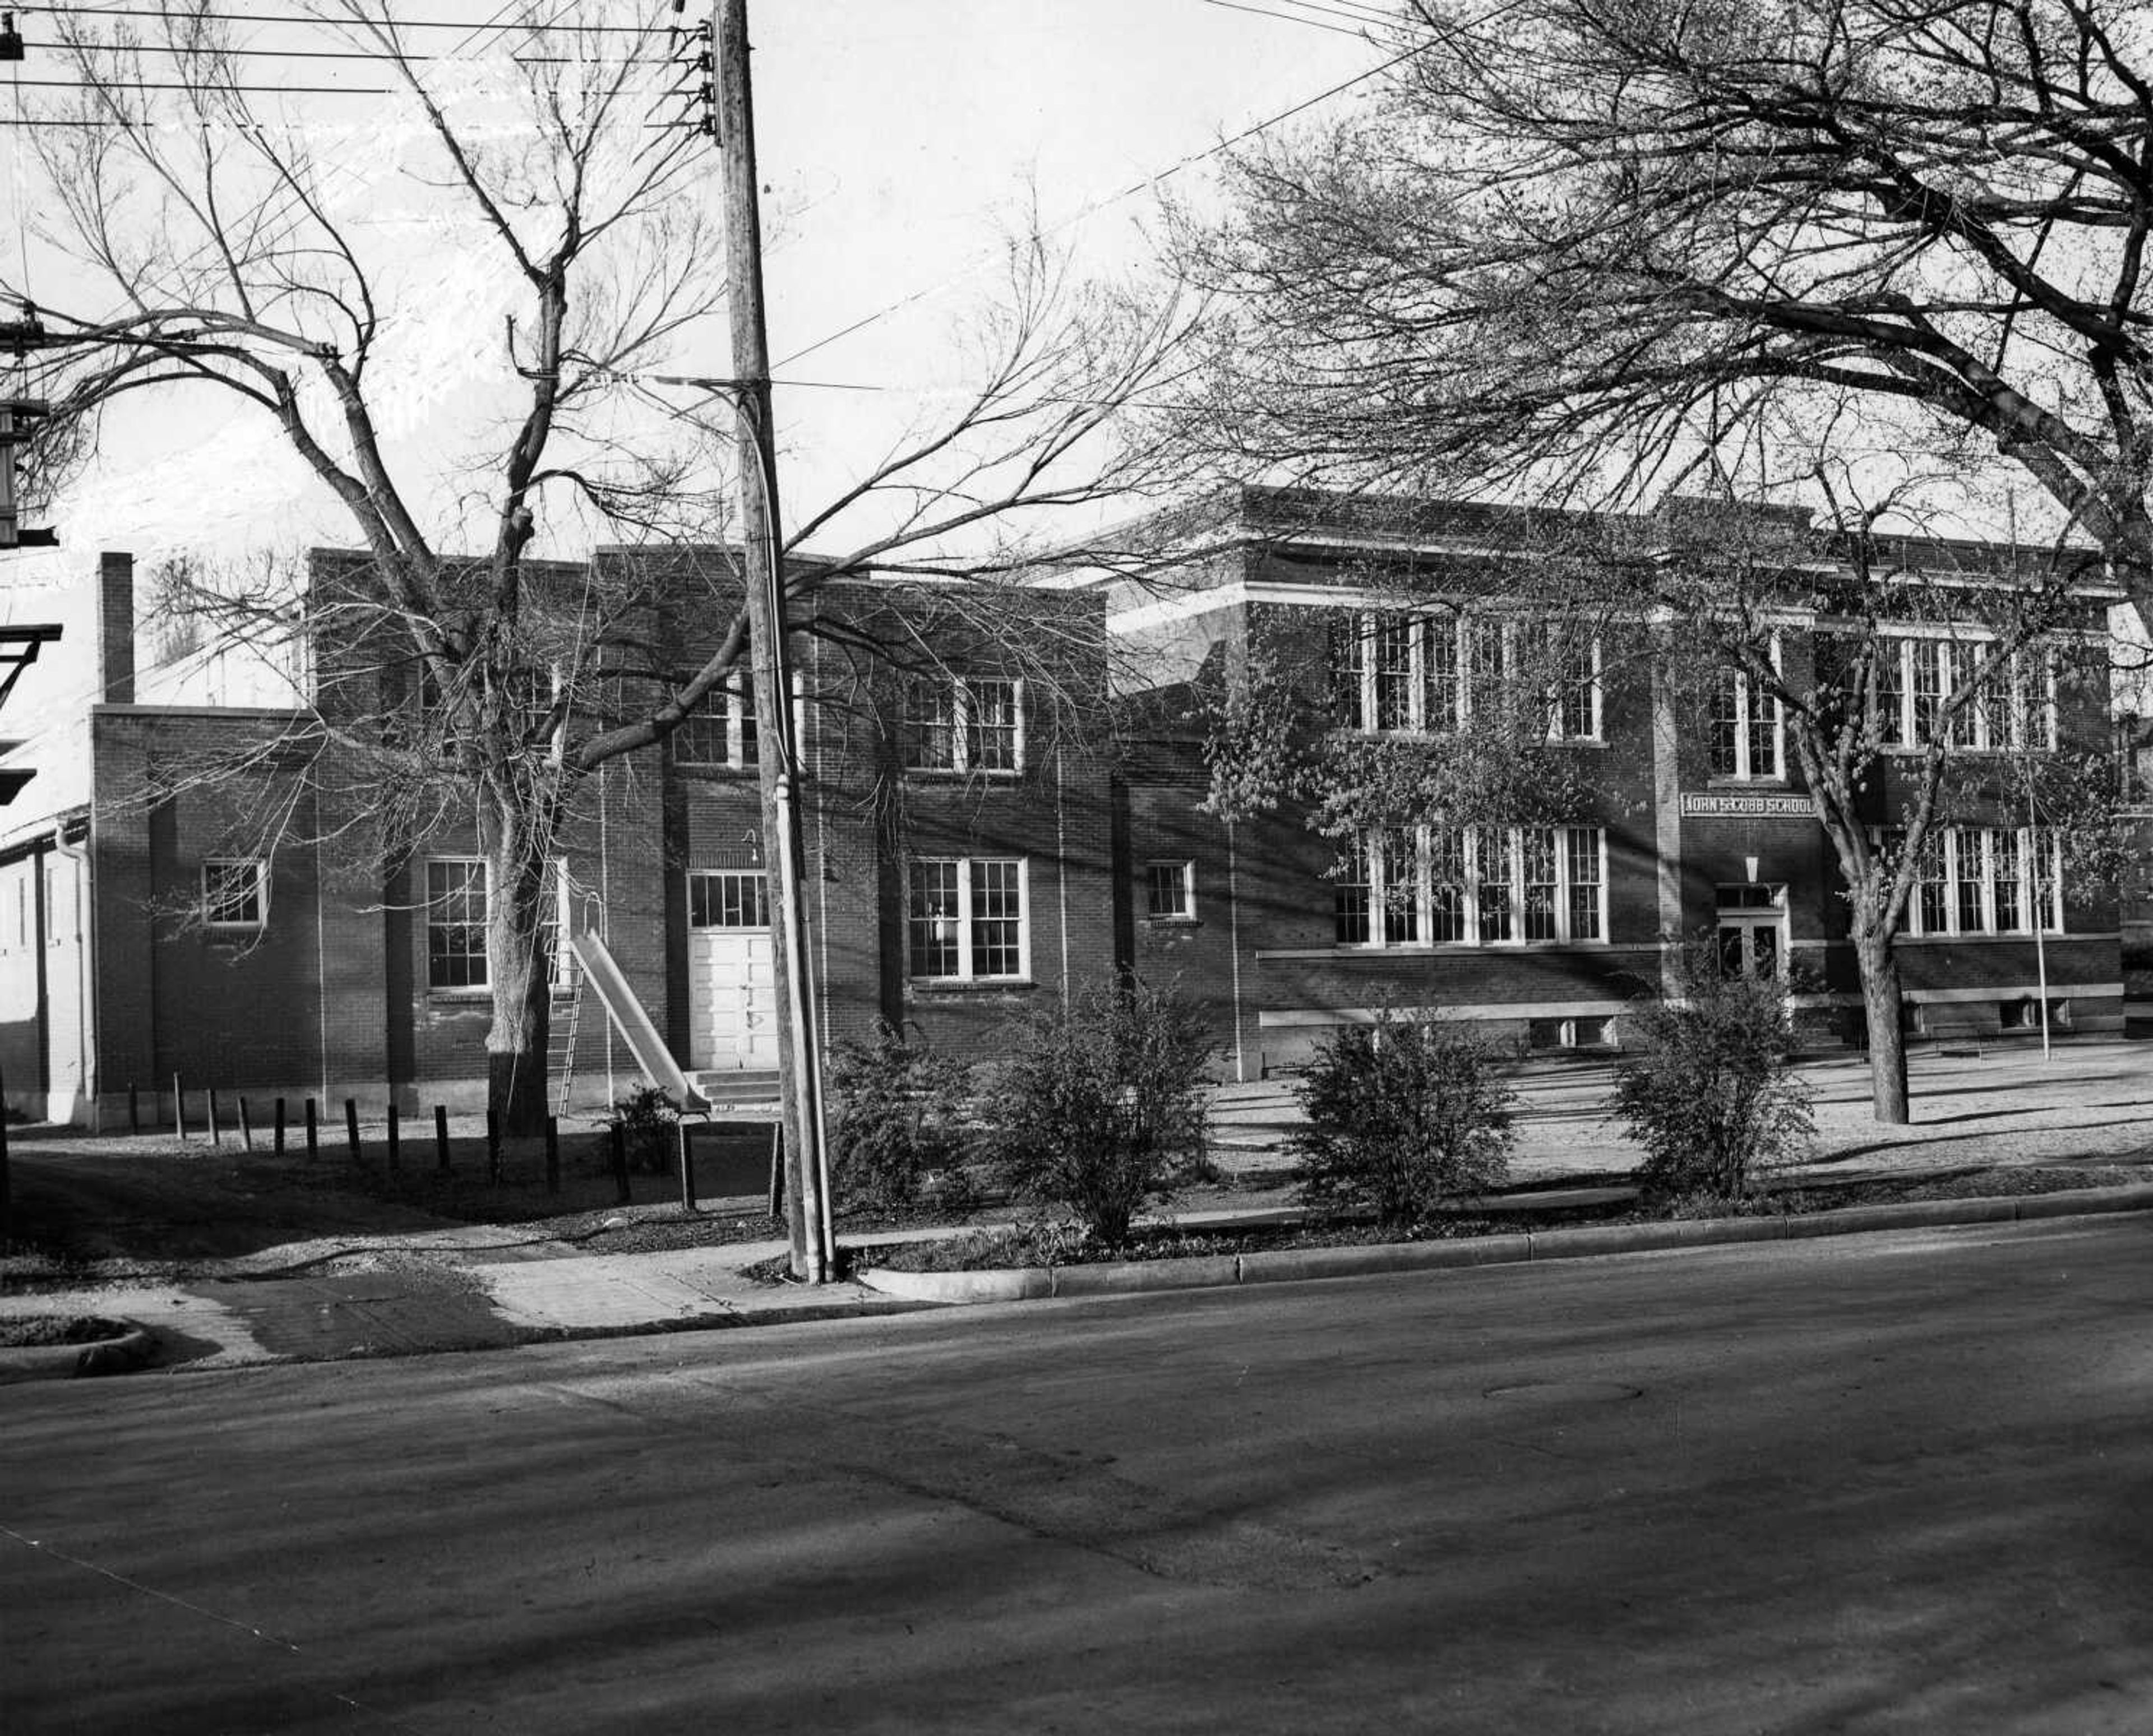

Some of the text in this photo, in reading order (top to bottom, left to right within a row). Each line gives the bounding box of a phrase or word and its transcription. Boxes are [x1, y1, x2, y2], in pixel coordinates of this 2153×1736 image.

[1685, 797, 1717, 811] JOHN
[1731, 798, 1764, 812] COBB
[1766, 798, 1813, 812] SCHOOL
